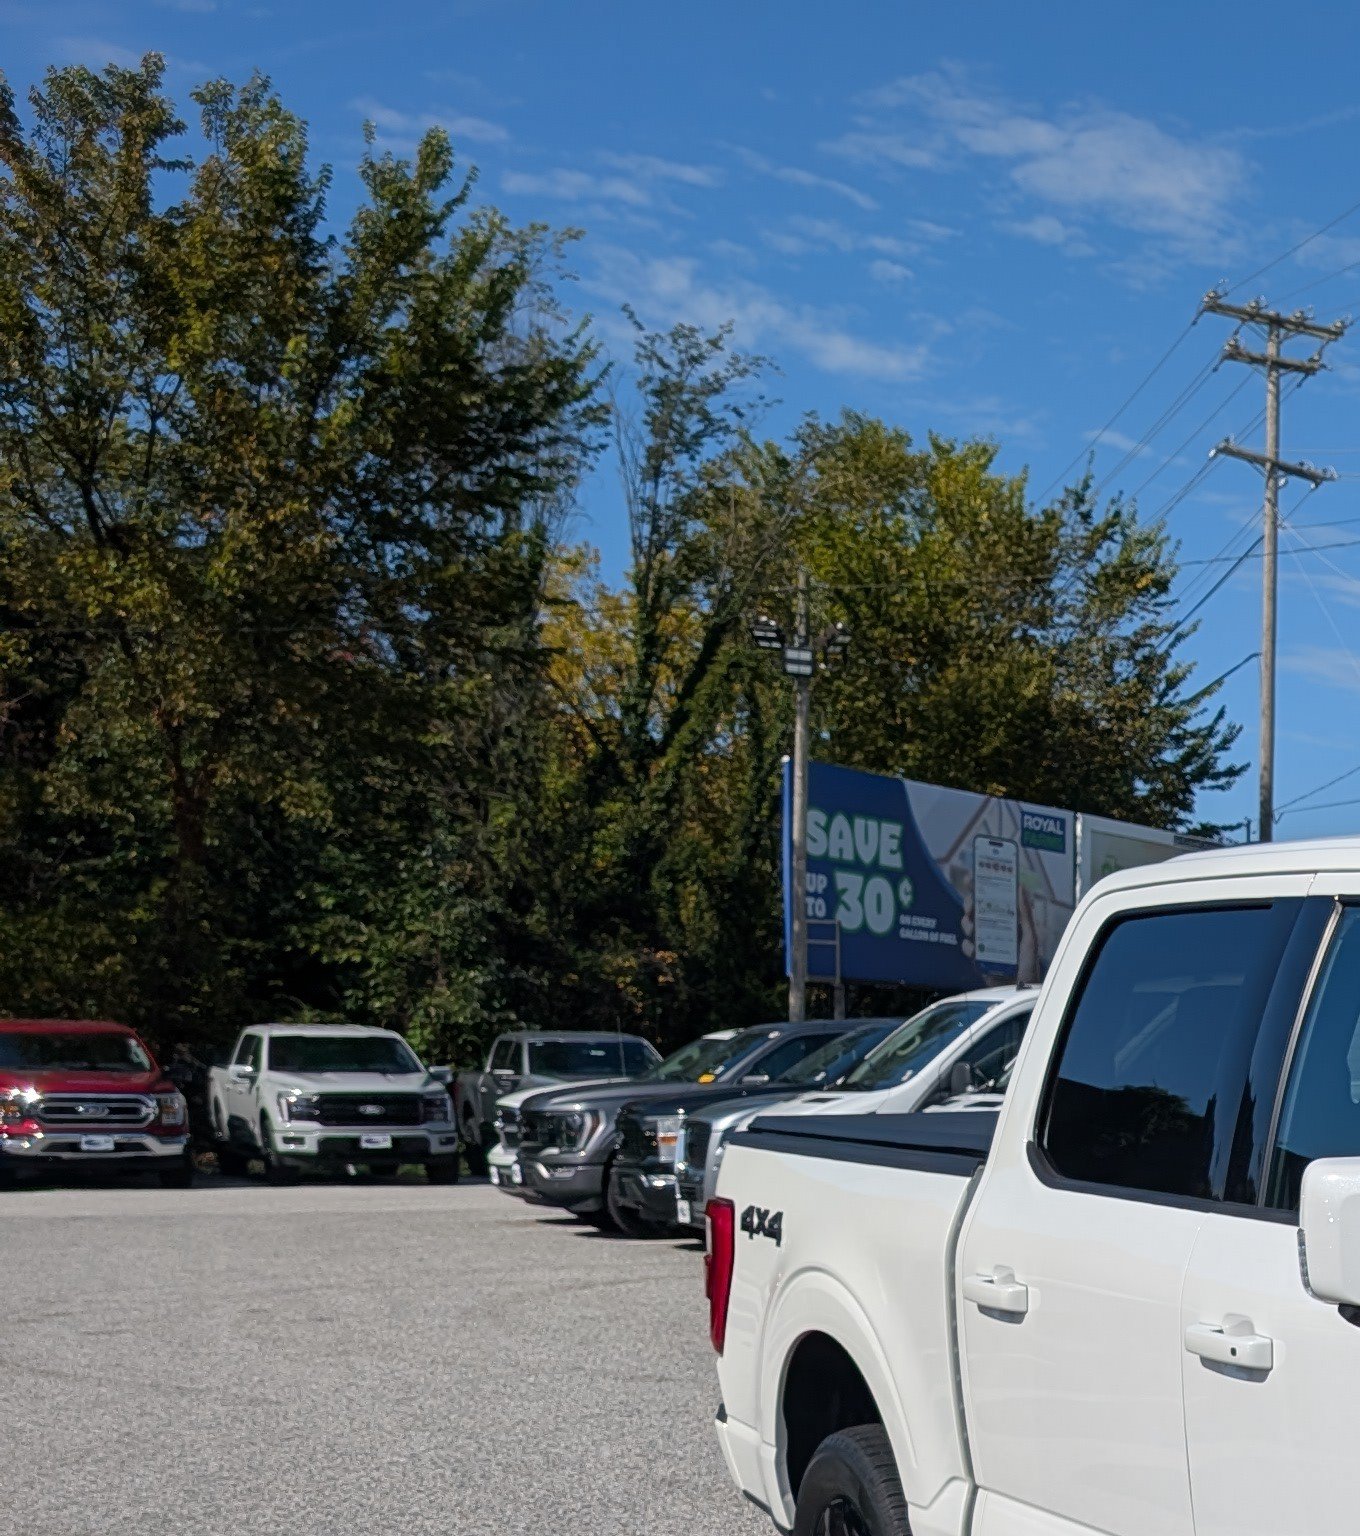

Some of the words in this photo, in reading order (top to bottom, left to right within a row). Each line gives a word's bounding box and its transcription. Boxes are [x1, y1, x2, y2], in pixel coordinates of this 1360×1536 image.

[1023, 814, 1065, 835] ROYAL
[806, 809, 904, 870] SAVE
[806, 872, 828, 893] UP
[806, 896, 827, 918] TO
